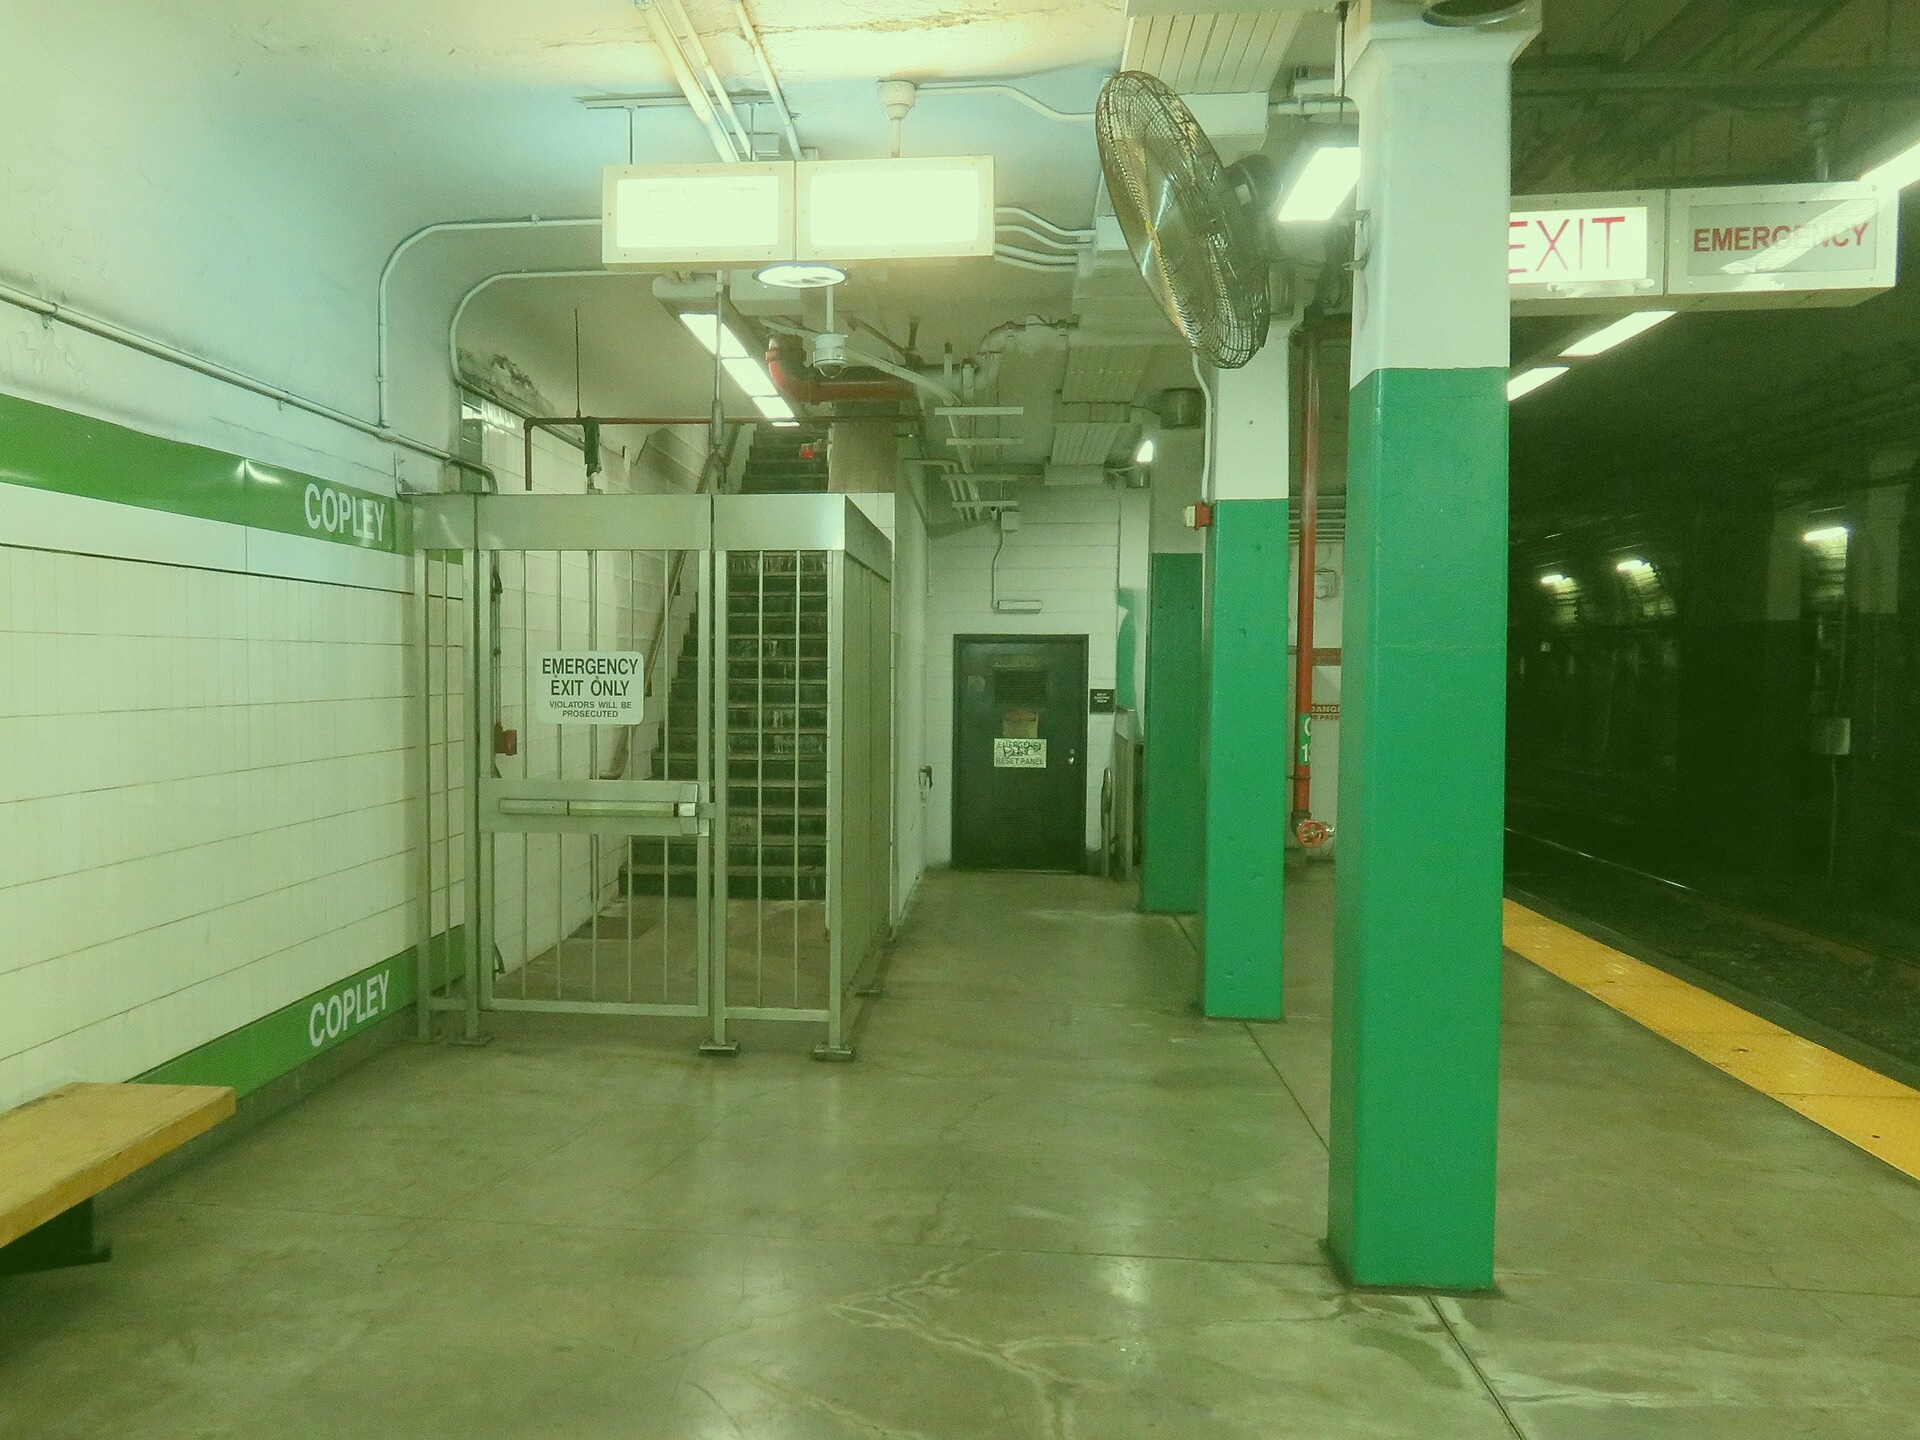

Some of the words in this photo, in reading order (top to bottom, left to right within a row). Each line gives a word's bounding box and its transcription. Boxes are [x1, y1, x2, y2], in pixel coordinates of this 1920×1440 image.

[1507, 216, 1626, 273] EXIT
[304, 483, 386, 542] COPLEY
[542, 658, 639, 675] EMERGENCY
[551, 680, 584, 696] EXIT
[590, 679, 630, 696] ONLY
[549, 701, 595, 709] VIOLATORS
[598, 701, 618, 709] WILL
[621, 701, 632, 709] BE
[562, 710, 619, 718] PROSECUTED
[996, 757, 1019, 765] RESET
[1020, 757, 1044, 765] PANEL
[308, 969, 390, 1048] COPLEY
